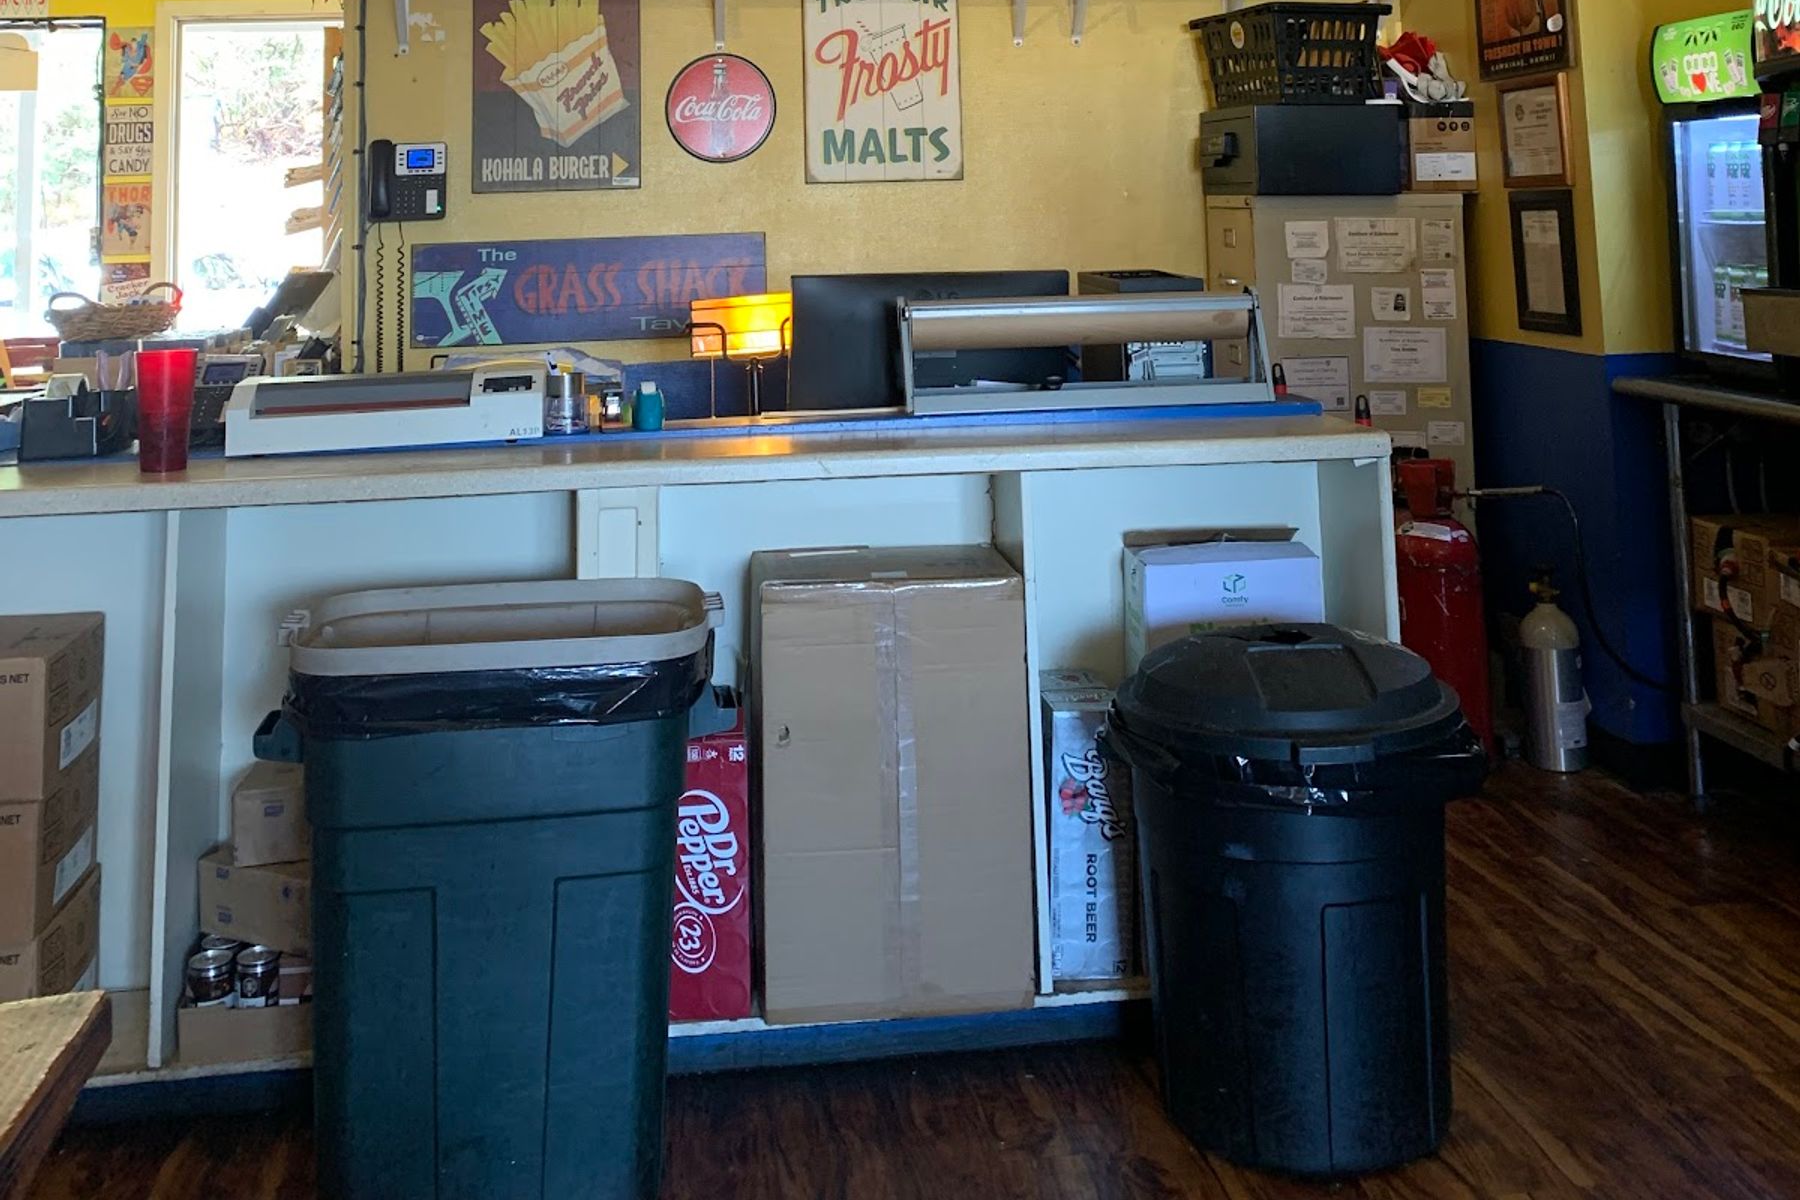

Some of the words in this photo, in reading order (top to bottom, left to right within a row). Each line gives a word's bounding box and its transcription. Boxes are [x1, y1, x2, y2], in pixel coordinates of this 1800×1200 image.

[815, 18, 952, 122] Frosty
[109, 123, 151, 143] DRUGS
[823, 126, 951, 165] MALTS
[109, 159, 149, 173] CANDY
[482, 157, 543, 182] KOHALA
[550, 155, 610, 180] BURGER
[109, 186, 150, 202] THOR
[477, 248, 517, 262] The
[514, 262, 625, 314] GRASS
[635, 257, 751, 311] SHACK
[9, 673, 29, 684] NET
[1062, 749, 1125, 841] Barq's
[677, 791, 730, 906] Pepper
[706, 833, 738, 876] Dr
[1085, 853, 1097, 898] ROOT
[678, 923, 701, 951] 23
[1085, 902, 1097, 944] BEER
